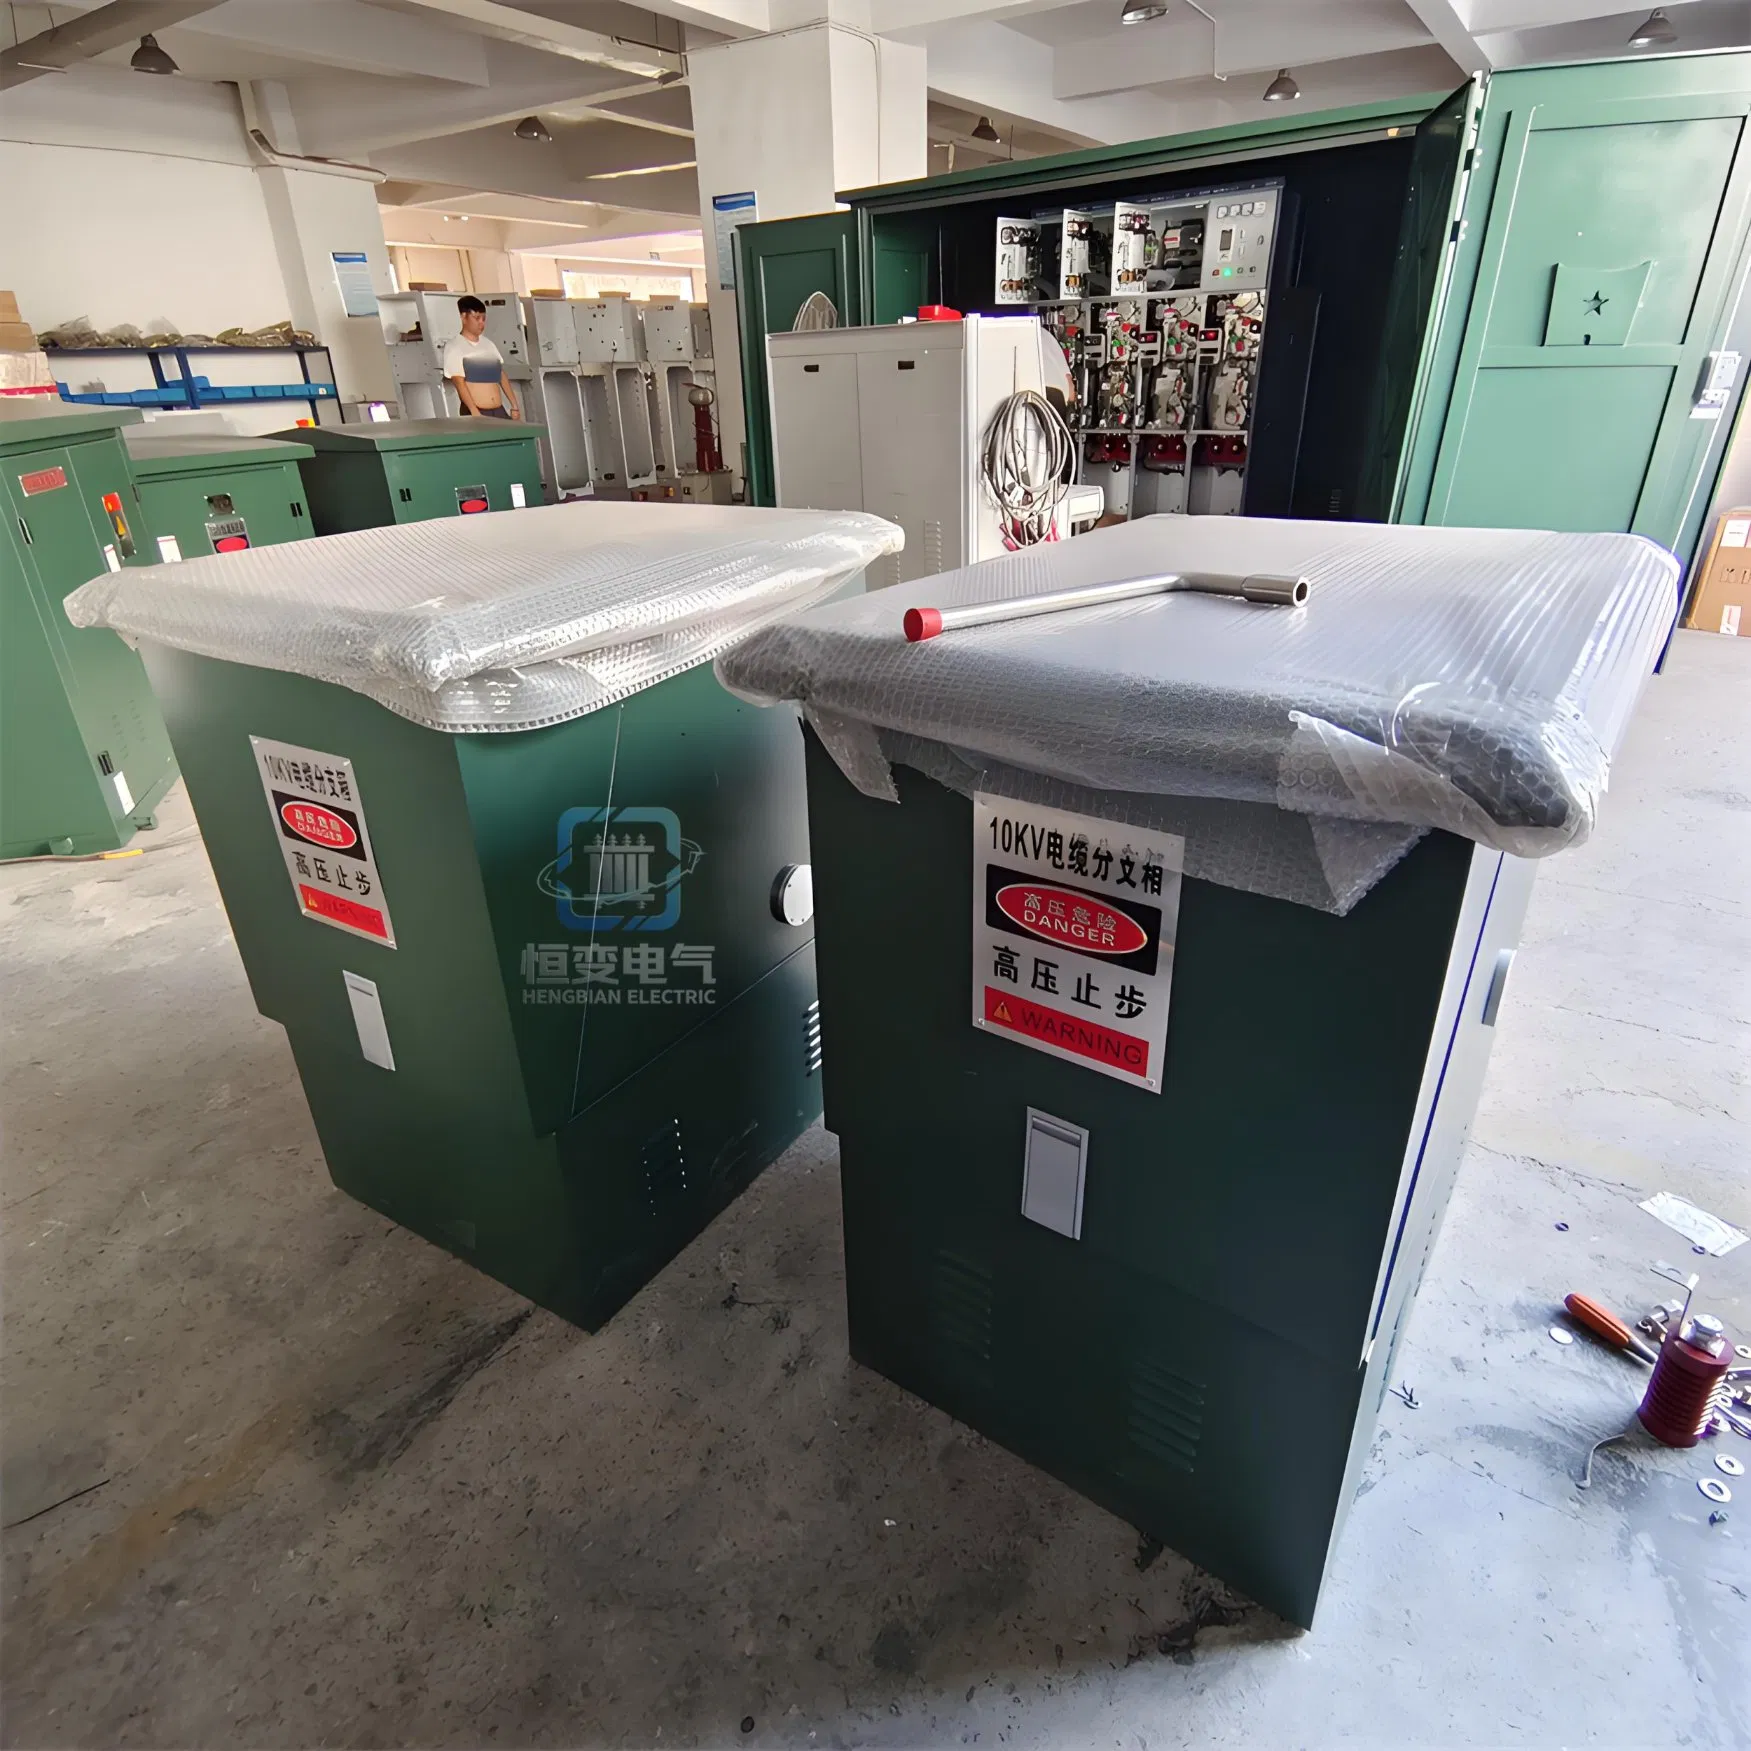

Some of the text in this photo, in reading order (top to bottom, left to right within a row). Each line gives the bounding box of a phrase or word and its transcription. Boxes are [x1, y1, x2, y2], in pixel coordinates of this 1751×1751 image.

[292, 851, 371, 895] 高压止步
[1023, 910, 1115, 946] DANGER
[992, 945, 1147, 1019] 高压止步
[1021, 1007, 1142, 1065] WARNING
